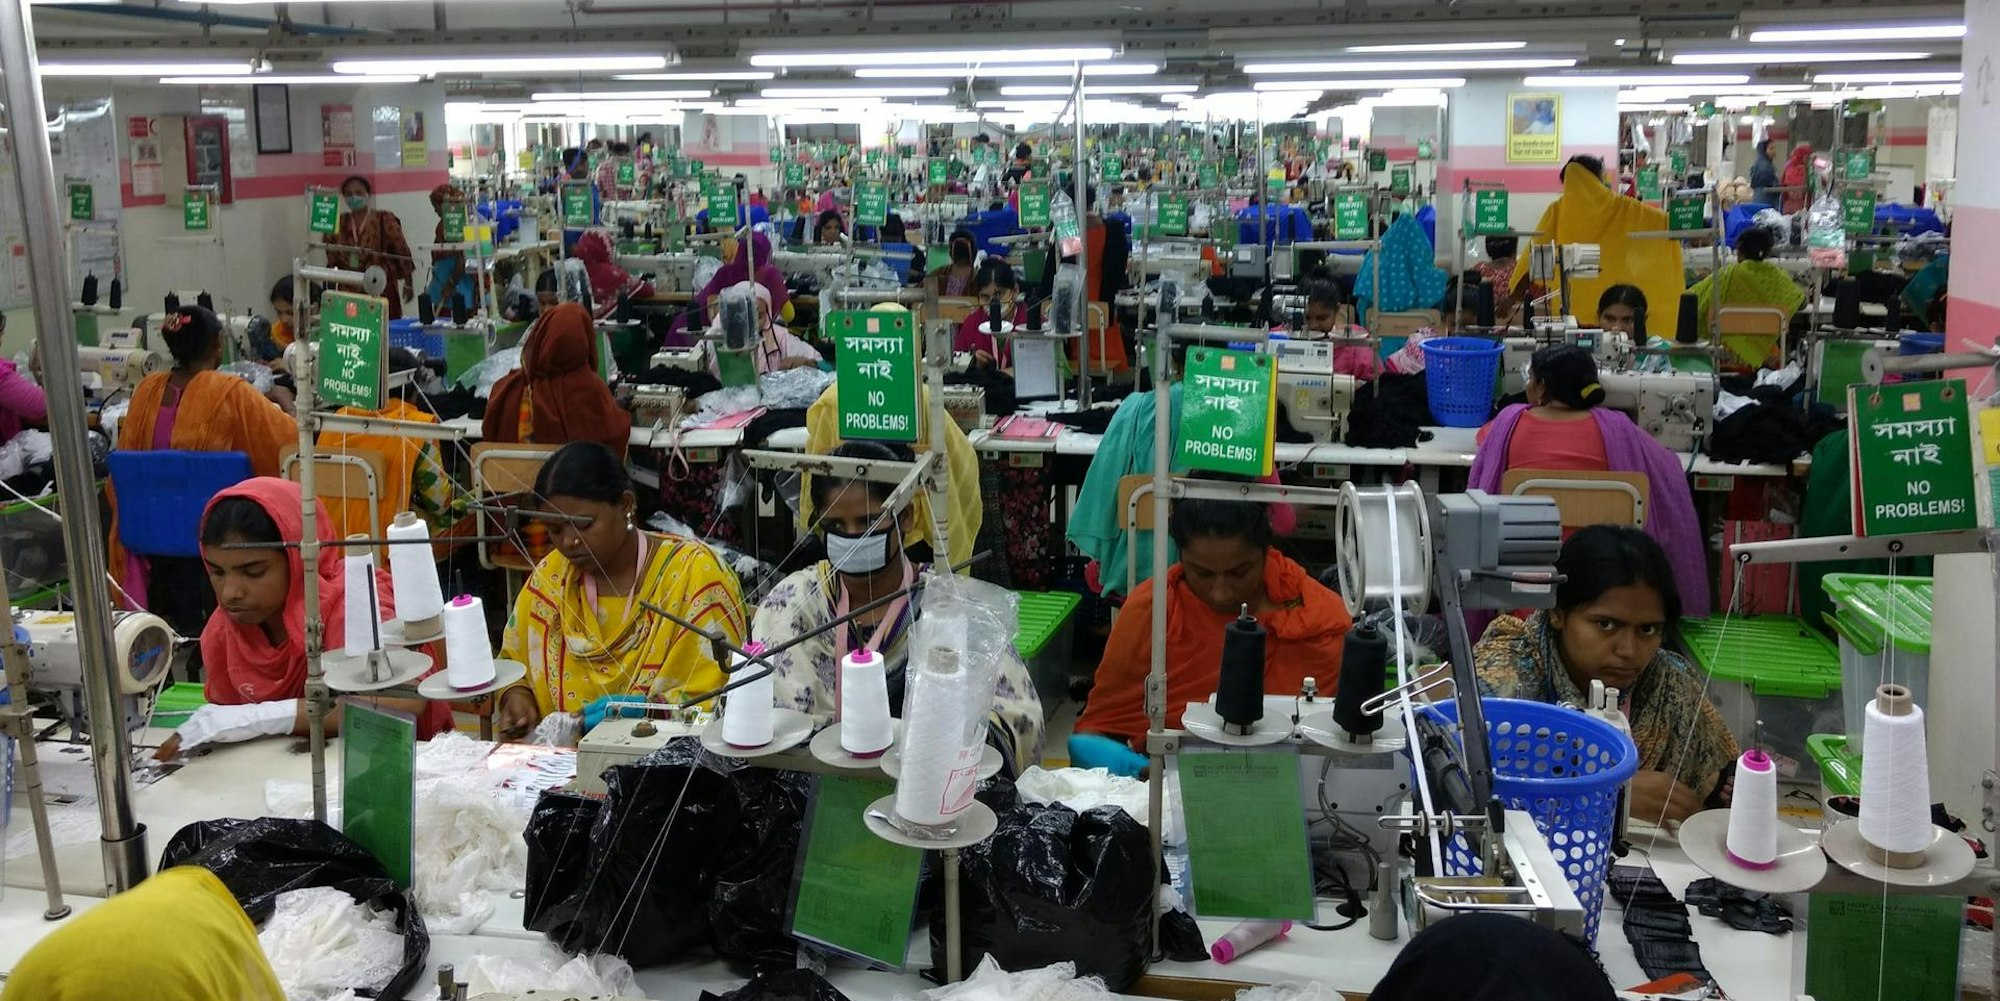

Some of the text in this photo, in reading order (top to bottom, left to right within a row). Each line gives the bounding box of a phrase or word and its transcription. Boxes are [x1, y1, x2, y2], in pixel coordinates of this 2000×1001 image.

[329, 322, 371, 343] সমস্যা
[336, 342, 362, 359] নাই
[843, 336, 904, 354] সমস্যা
[341, 367, 355, 380] NO
[857, 358, 893, 381] নাই
[323, 378, 372, 398] PROBLEMS!
[1194, 374, 1260, 394] সমস্যা
[868, 390, 885, 407] NO
[1203, 394, 1241, 413] নাই
[846, 412, 909, 431] PROBLEMS!
[1872, 416, 1956, 440] সমস্যা
[1211, 424, 1233, 440] NO
[1185, 439, 1257, 462] PROBLEMS!
[1890, 443, 1942, 466] নাই
[1907, 480, 1930, 496] NO
[1876, 499, 1965, 519] PROBLEMS!
